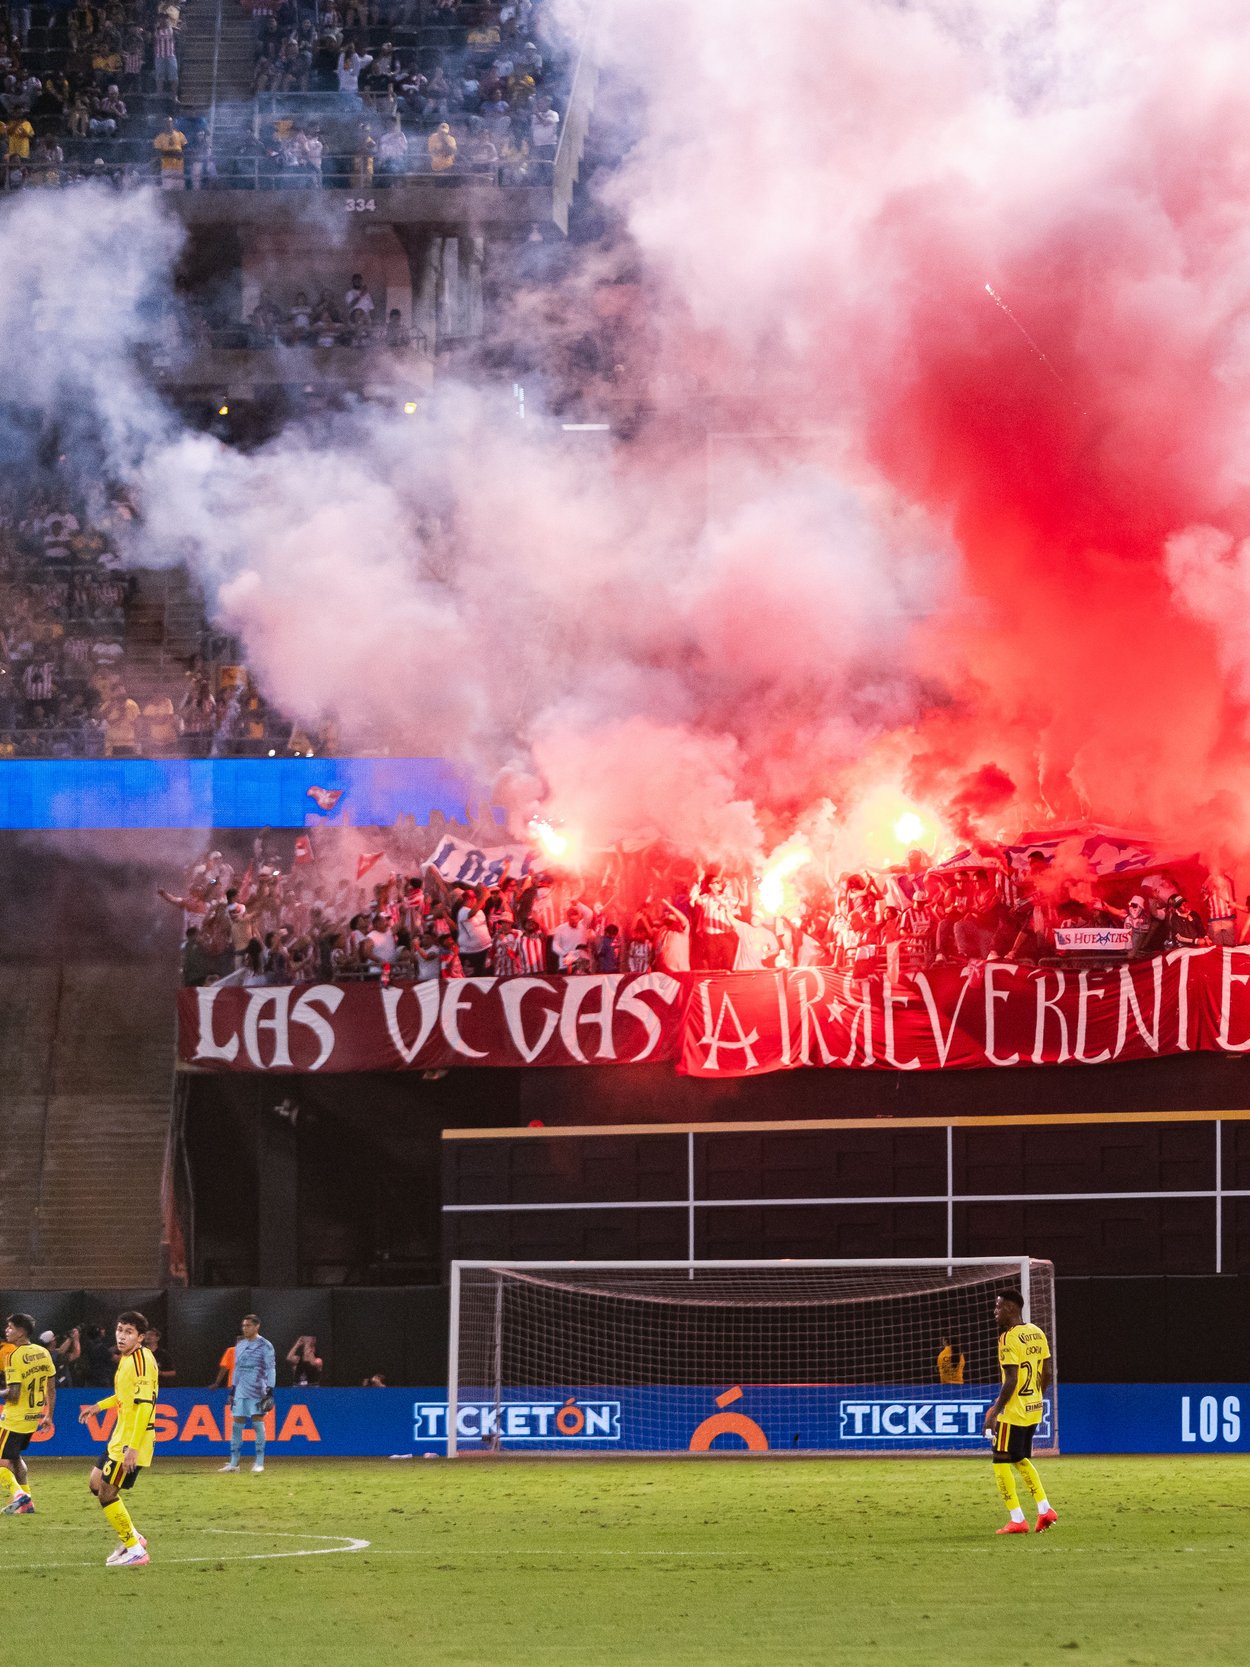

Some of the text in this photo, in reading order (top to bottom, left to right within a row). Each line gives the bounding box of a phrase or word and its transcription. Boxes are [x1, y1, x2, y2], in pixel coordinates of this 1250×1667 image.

[345, 198, 376, 211] 334
[192, 972, 682, 1070] LAS VEGAS
[28, 1376, 47, 1408] 15
[80, 1404, 321, 1442] VSALIA
[847, 1404, 992, 1434] TICKET
[1181, 1396, 1240, 1443] LOS
